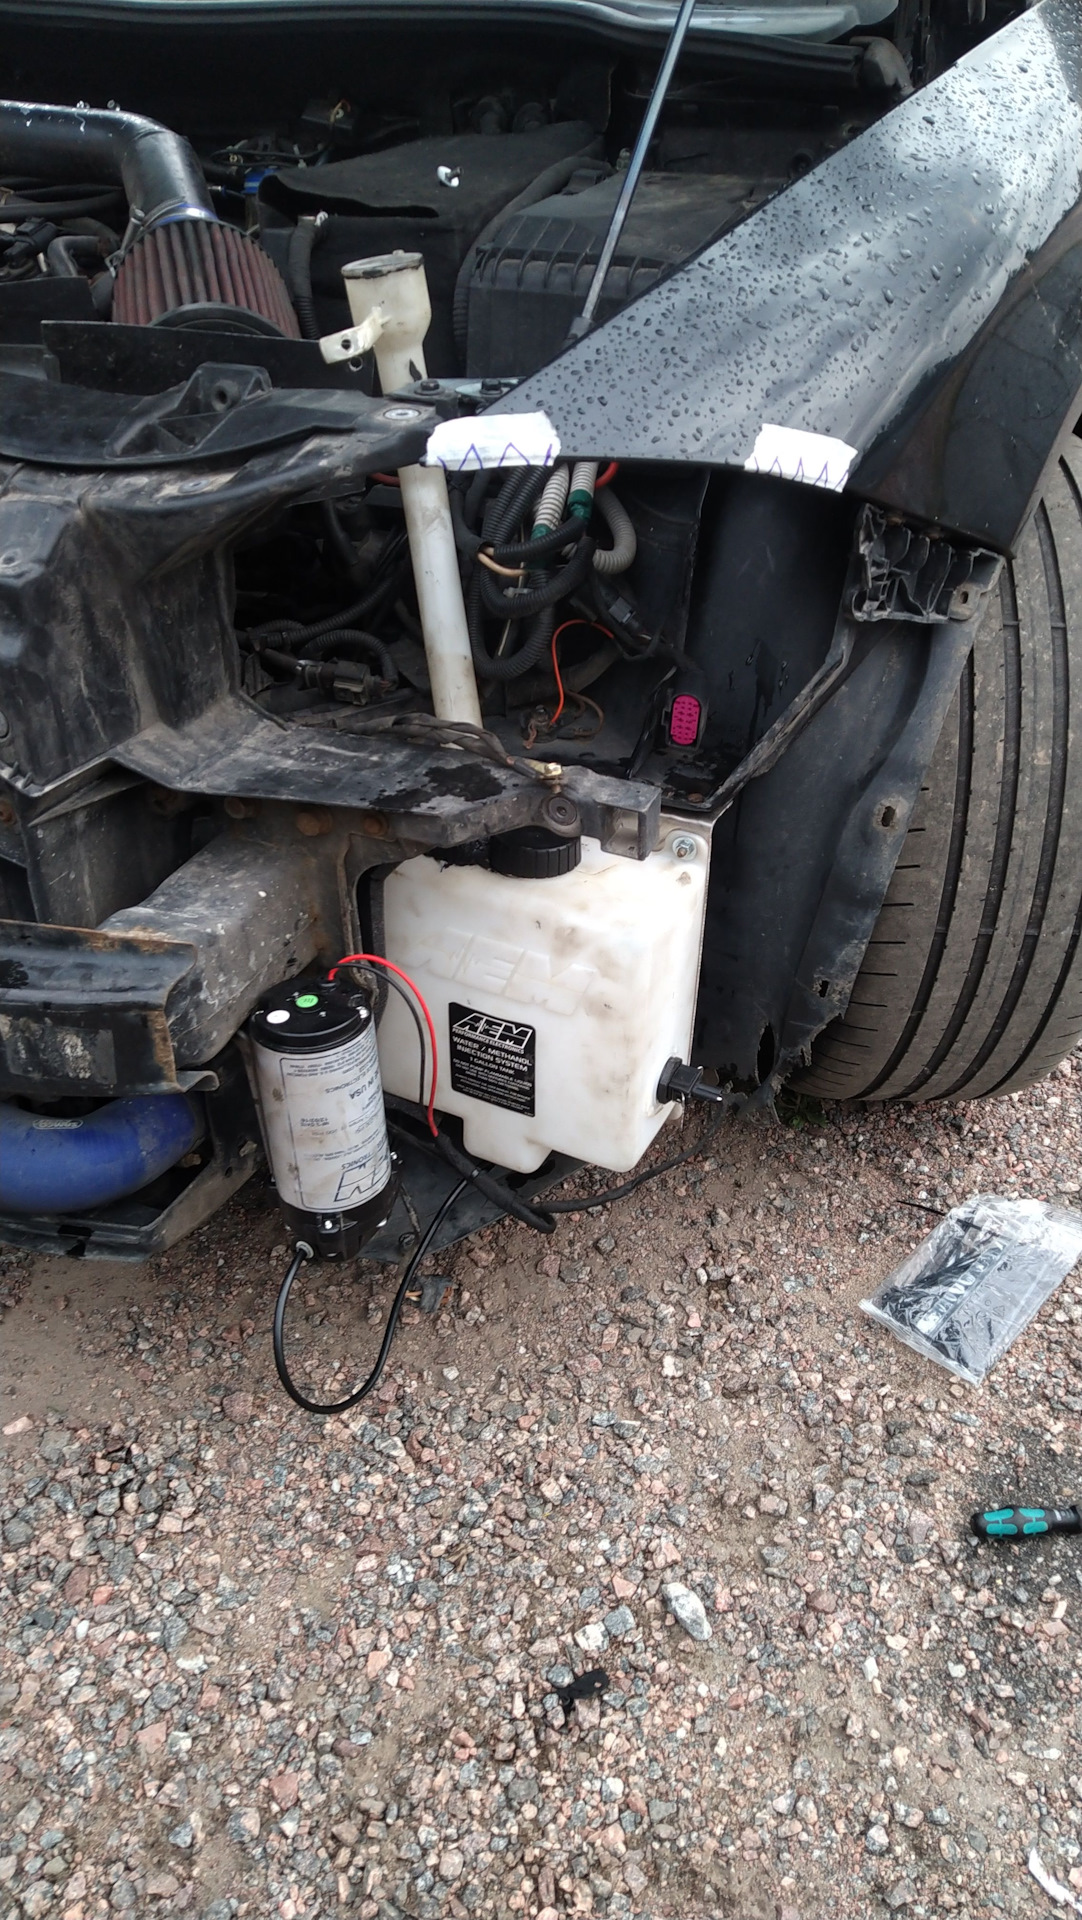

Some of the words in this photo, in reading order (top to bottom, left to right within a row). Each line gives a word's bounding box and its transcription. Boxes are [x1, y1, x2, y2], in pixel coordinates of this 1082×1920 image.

[452, 1013, 533, 1049] AEM
[452, 1028, 490, 1044] PERFORMANCE
[489, 1040, 524, 1054] ELECTRONICS
[452, 1036, 479, 1049] WATER
[488, 1048, 532, 1066] METHANOL
[456, 1045, 494, 1060] INJECTION
[495, 1057, 528, 1072] SYSTEM
[473, 1058, 499, 1070] GALLON
[499, 1065, 516, 1075] TANK
[349, 1084, 367, 1100] USA
